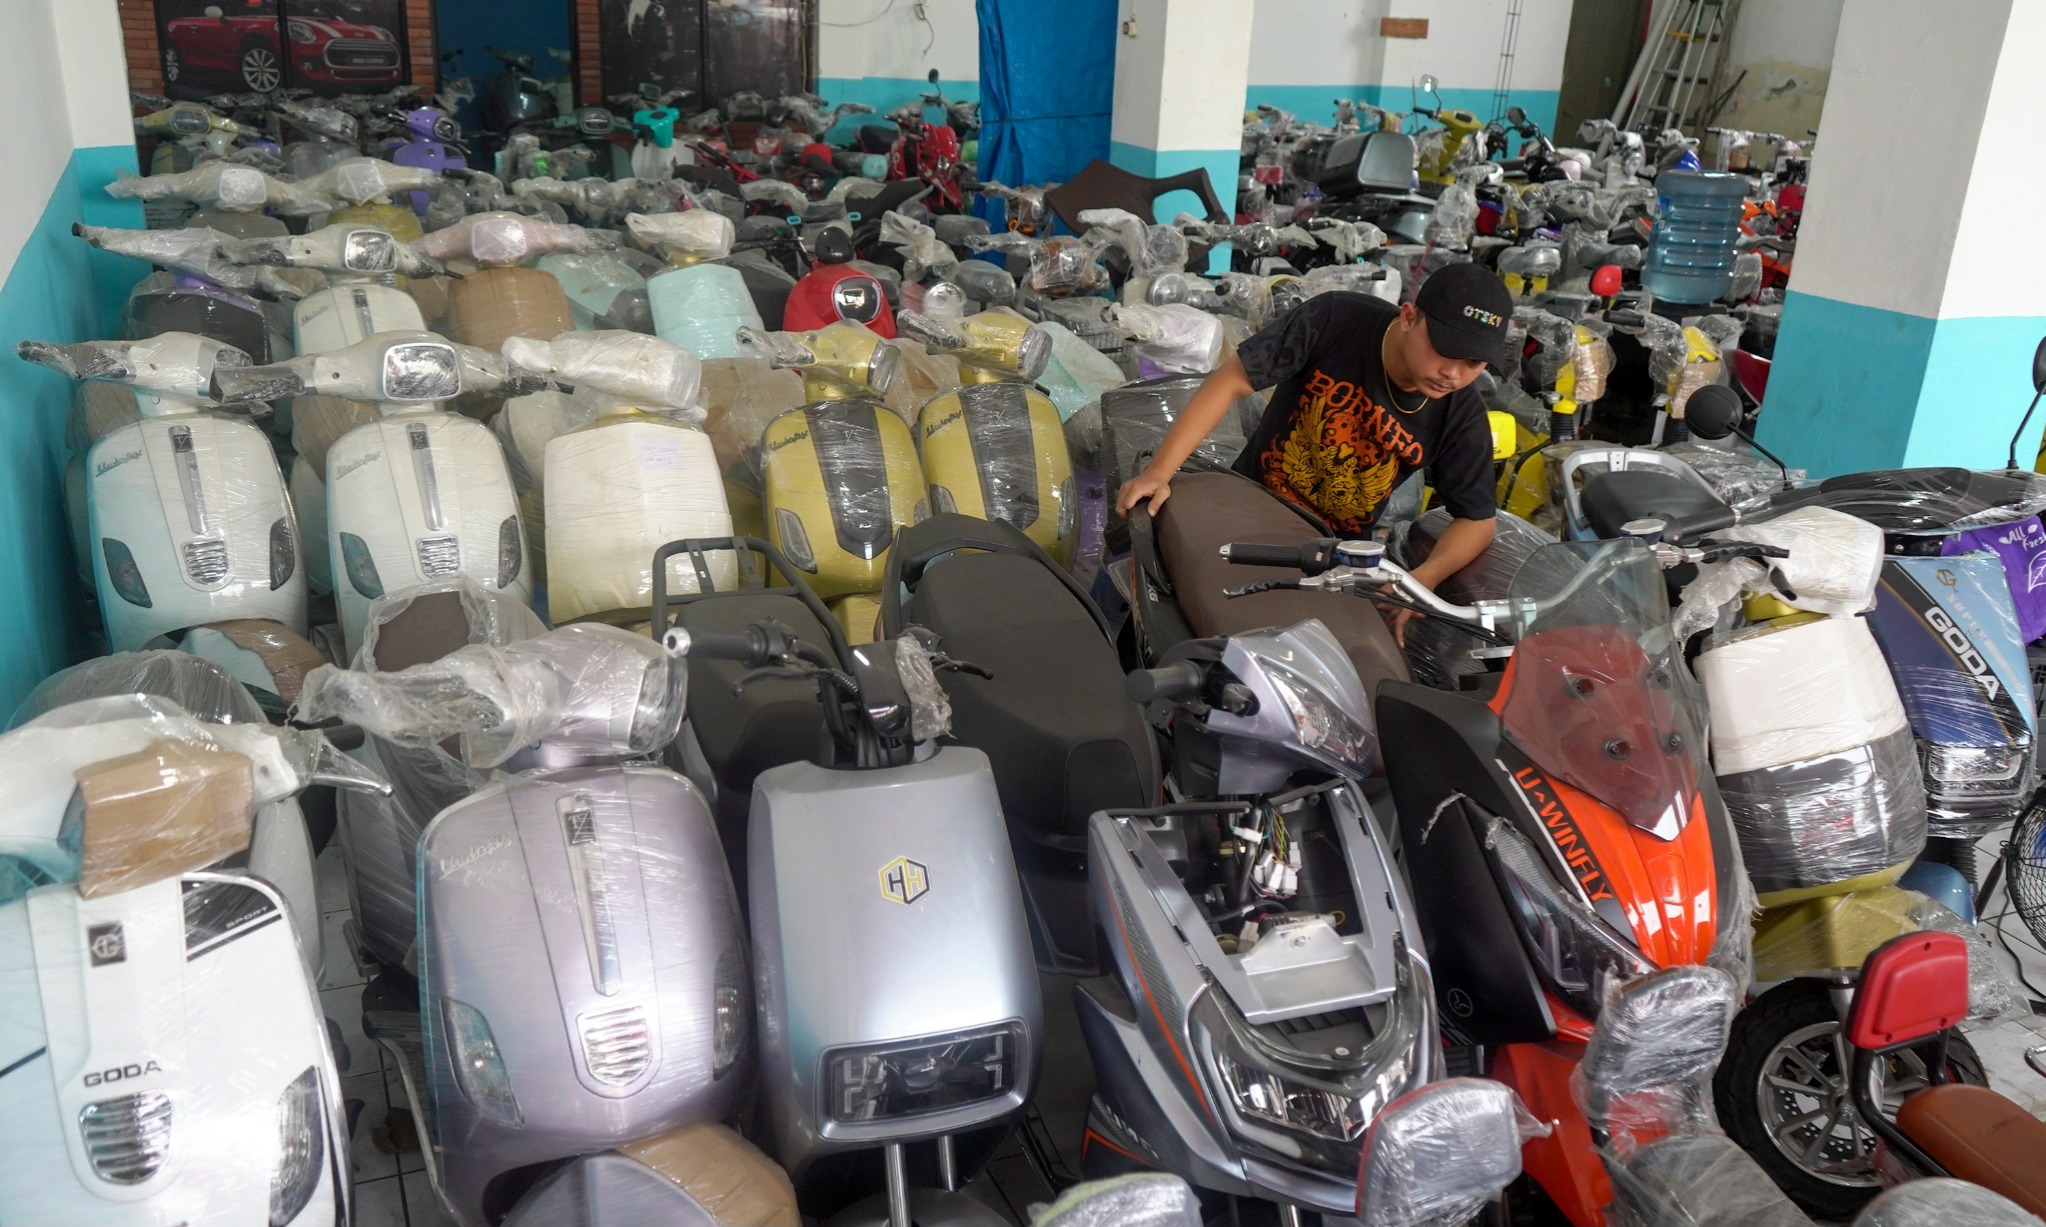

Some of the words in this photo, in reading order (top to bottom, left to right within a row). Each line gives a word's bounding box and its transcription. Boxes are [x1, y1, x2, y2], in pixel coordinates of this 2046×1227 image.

[1463, 304, 1504, 328] OTSKY
[1924, 606, 2000, 701] GODA
[225, 905, 269, 930] SPORT
[83, 1060, 162, 1088] GODA
